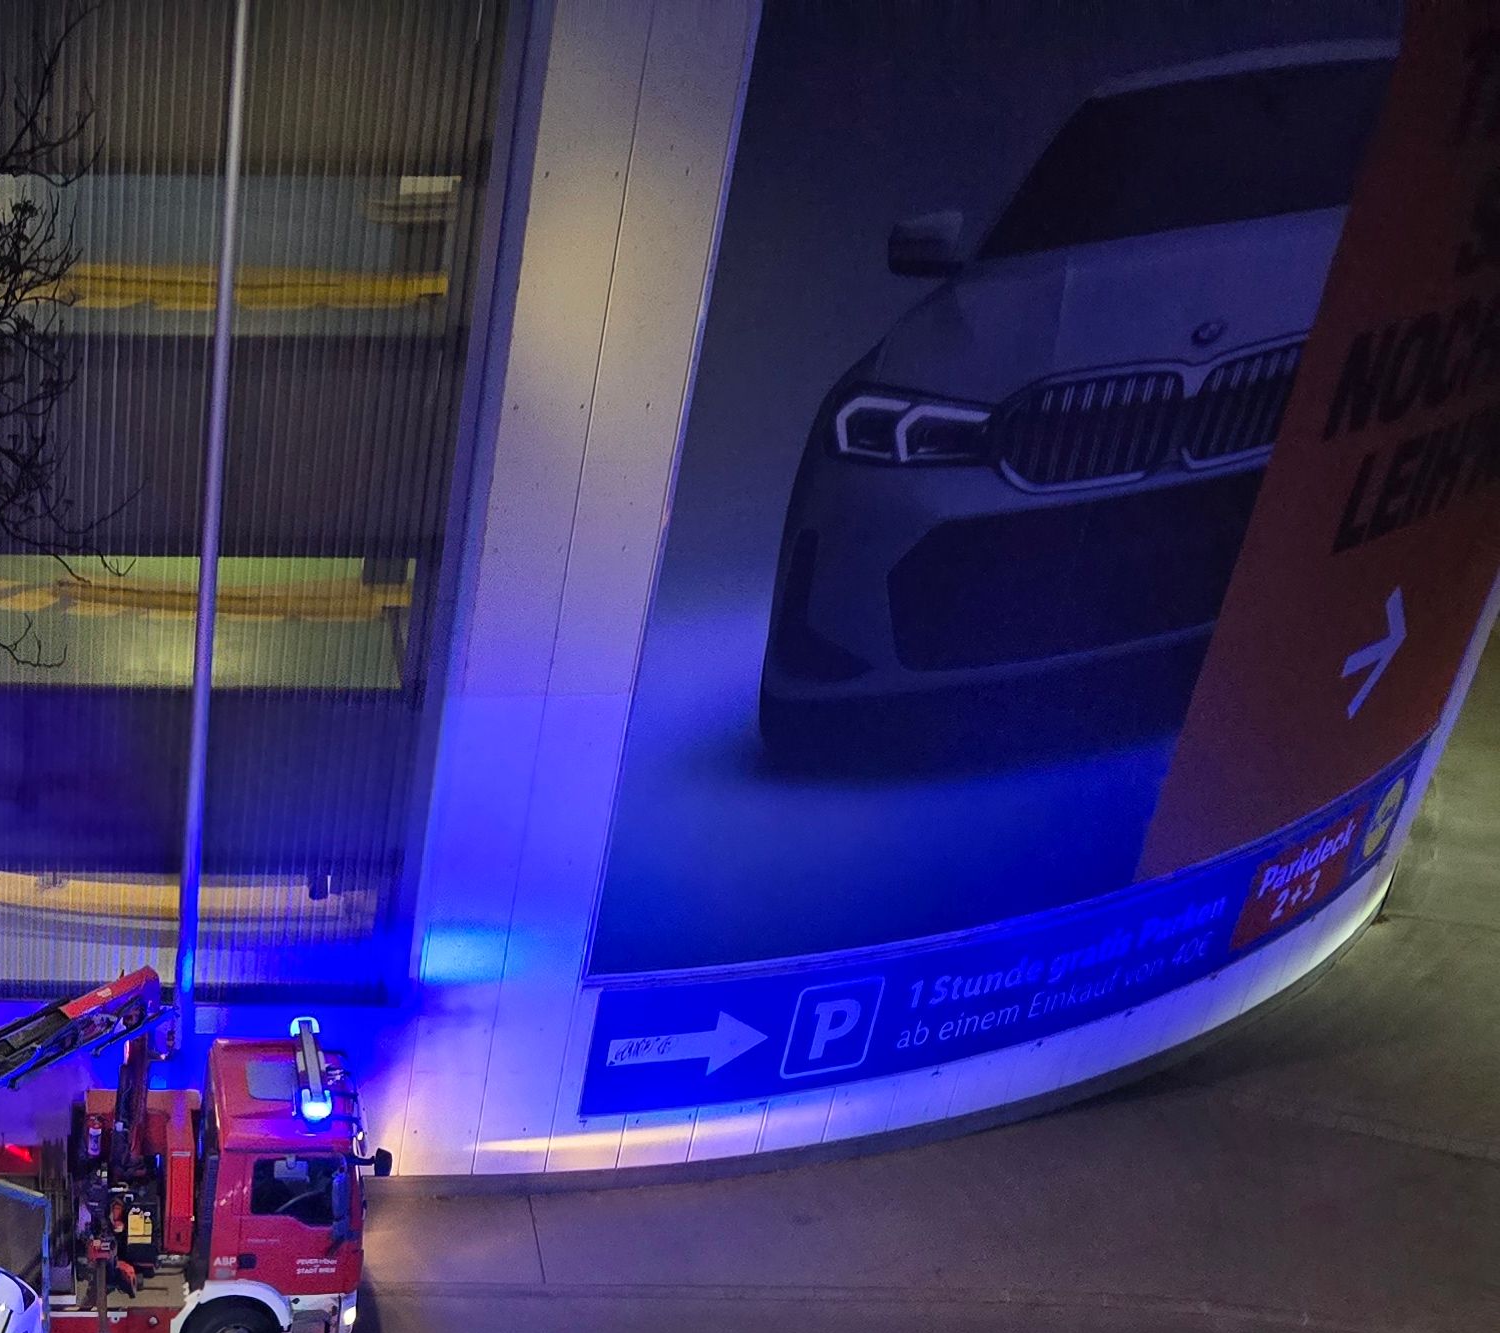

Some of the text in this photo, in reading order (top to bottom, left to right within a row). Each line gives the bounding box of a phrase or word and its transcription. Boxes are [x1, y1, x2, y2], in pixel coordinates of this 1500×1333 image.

[1257, 819, 1356, 899] Parkdeck
[910, 896, 1228, 1008] 1 Stunde gratis Parken
[808, 998, 862, 1061] P
[896, 1020, 929, 1049] ab
[938, 1003, 1020, 1041] einem
[1027, 967, 1122, 1018] Einkauf
[1124, 957, 1164, 987] von
